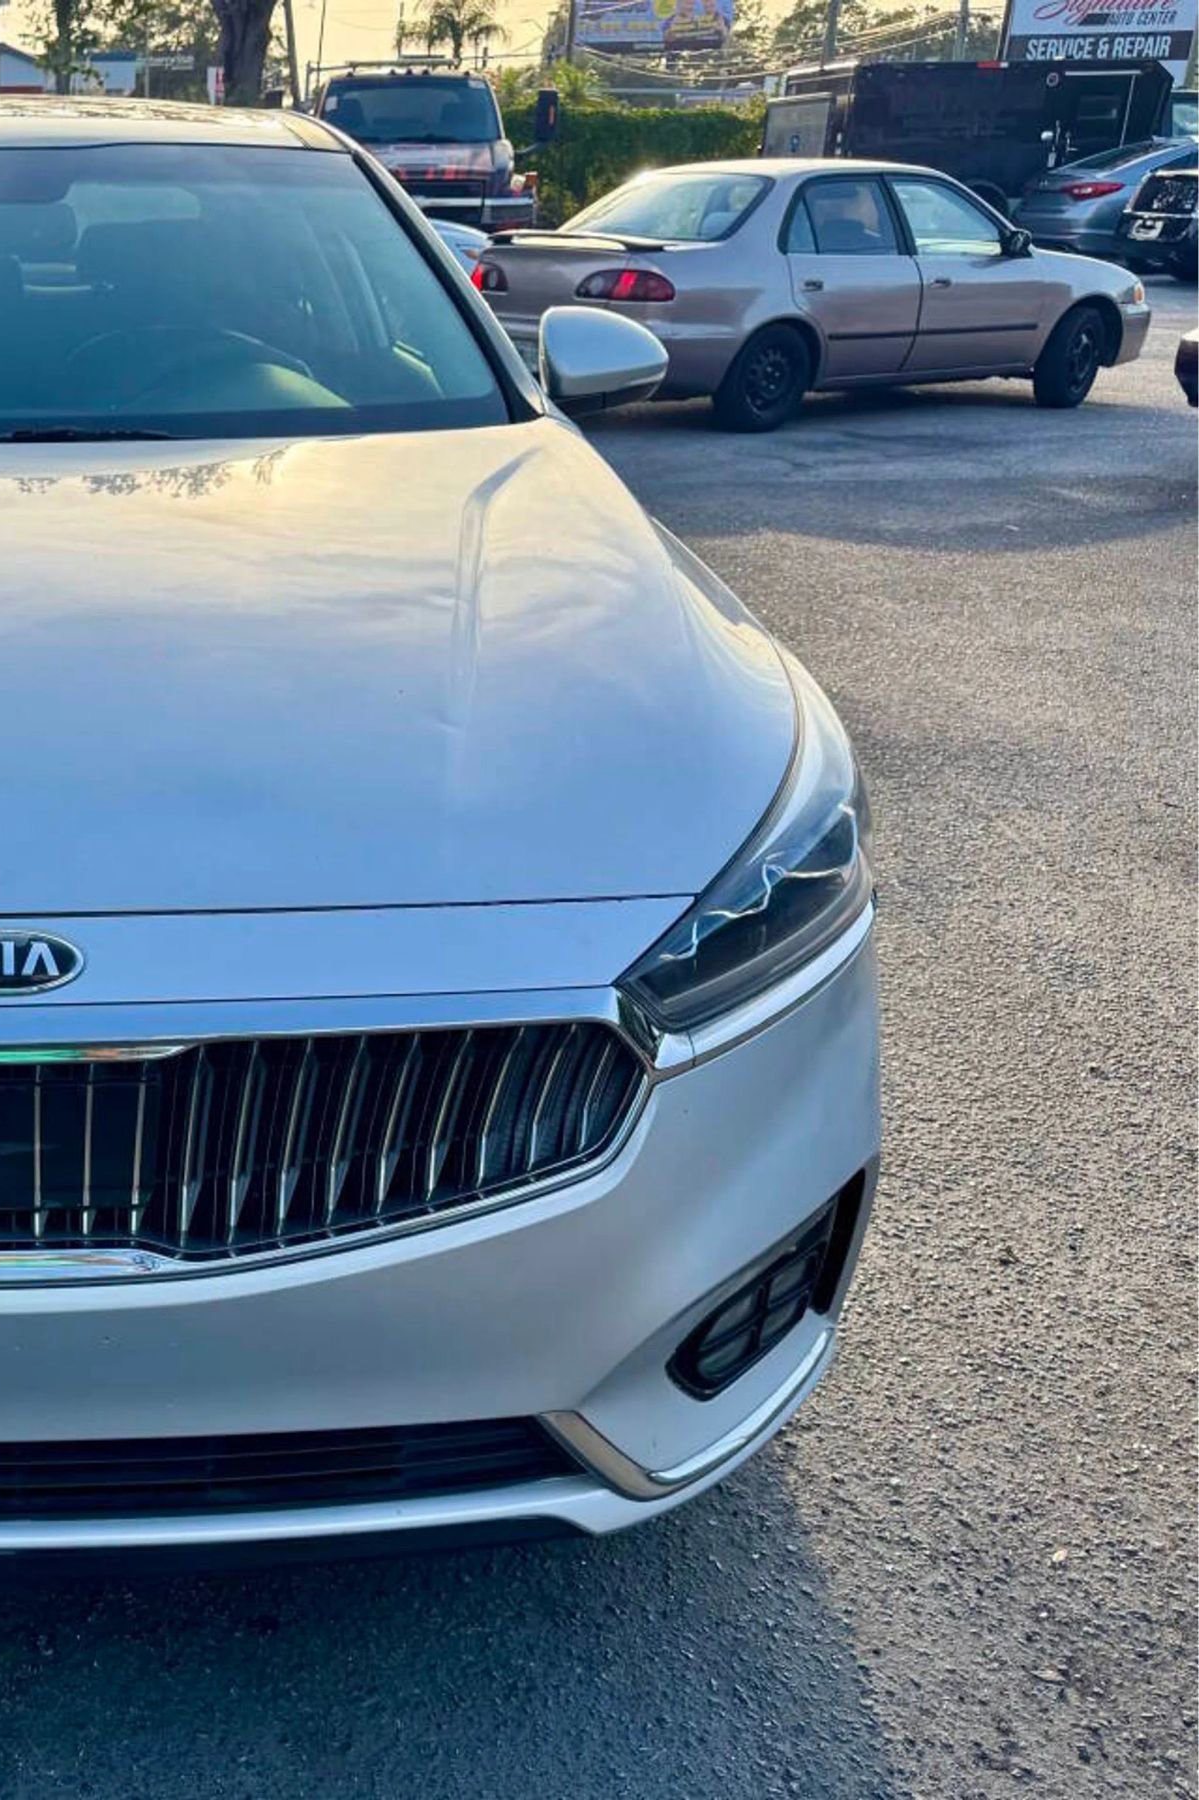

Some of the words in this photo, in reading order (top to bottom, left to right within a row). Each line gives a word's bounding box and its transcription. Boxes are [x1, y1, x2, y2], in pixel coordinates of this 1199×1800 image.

[1107, 11, 1135, 26] AUTO
[1136, 10, 1178, 25] CENTER
[1025, 37, 1095, 61] SERVICE
[1096, 37, 1110, 60] &
[1112, 35, 1172, 60] REPAIR
